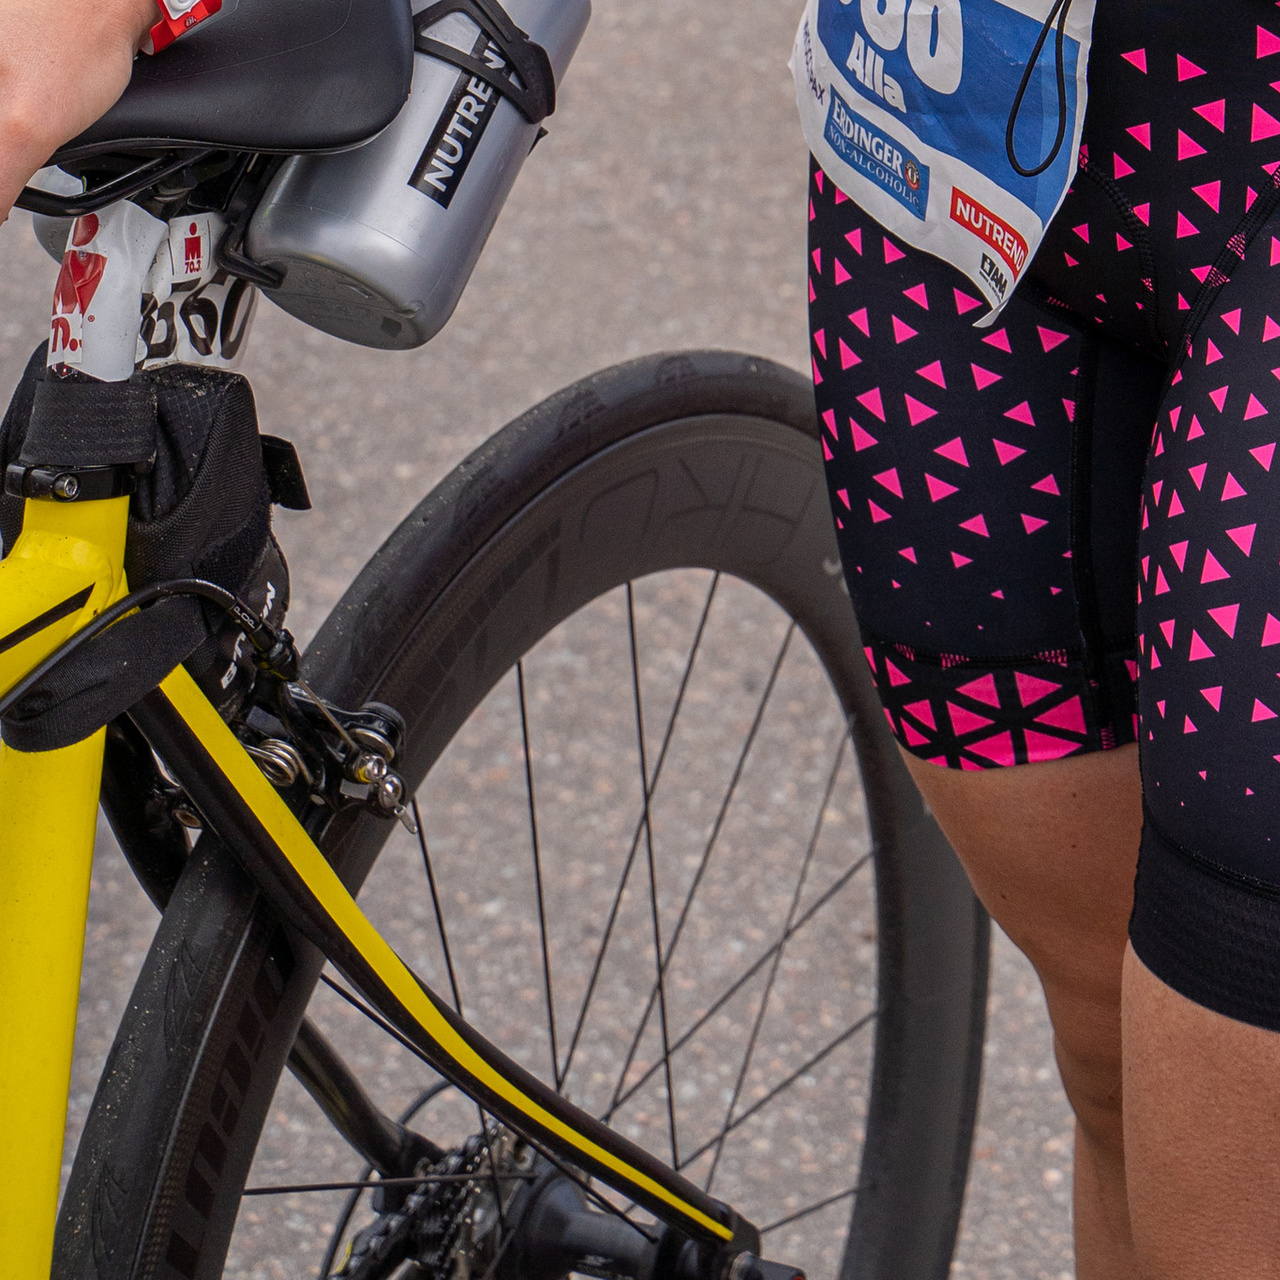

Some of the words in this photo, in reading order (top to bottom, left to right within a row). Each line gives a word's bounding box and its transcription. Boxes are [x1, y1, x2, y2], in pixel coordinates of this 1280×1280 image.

[846, 30, 908, 114] Alla
[828, 124, 921, 210] NON-ALCOHOLIC
[832, 96, 904, 179] ERDINGER
[184, 259, 202, 275] 70.3
[955, 197, 1025, 272] NUTREND
[233, 605, 256, 630] POP
